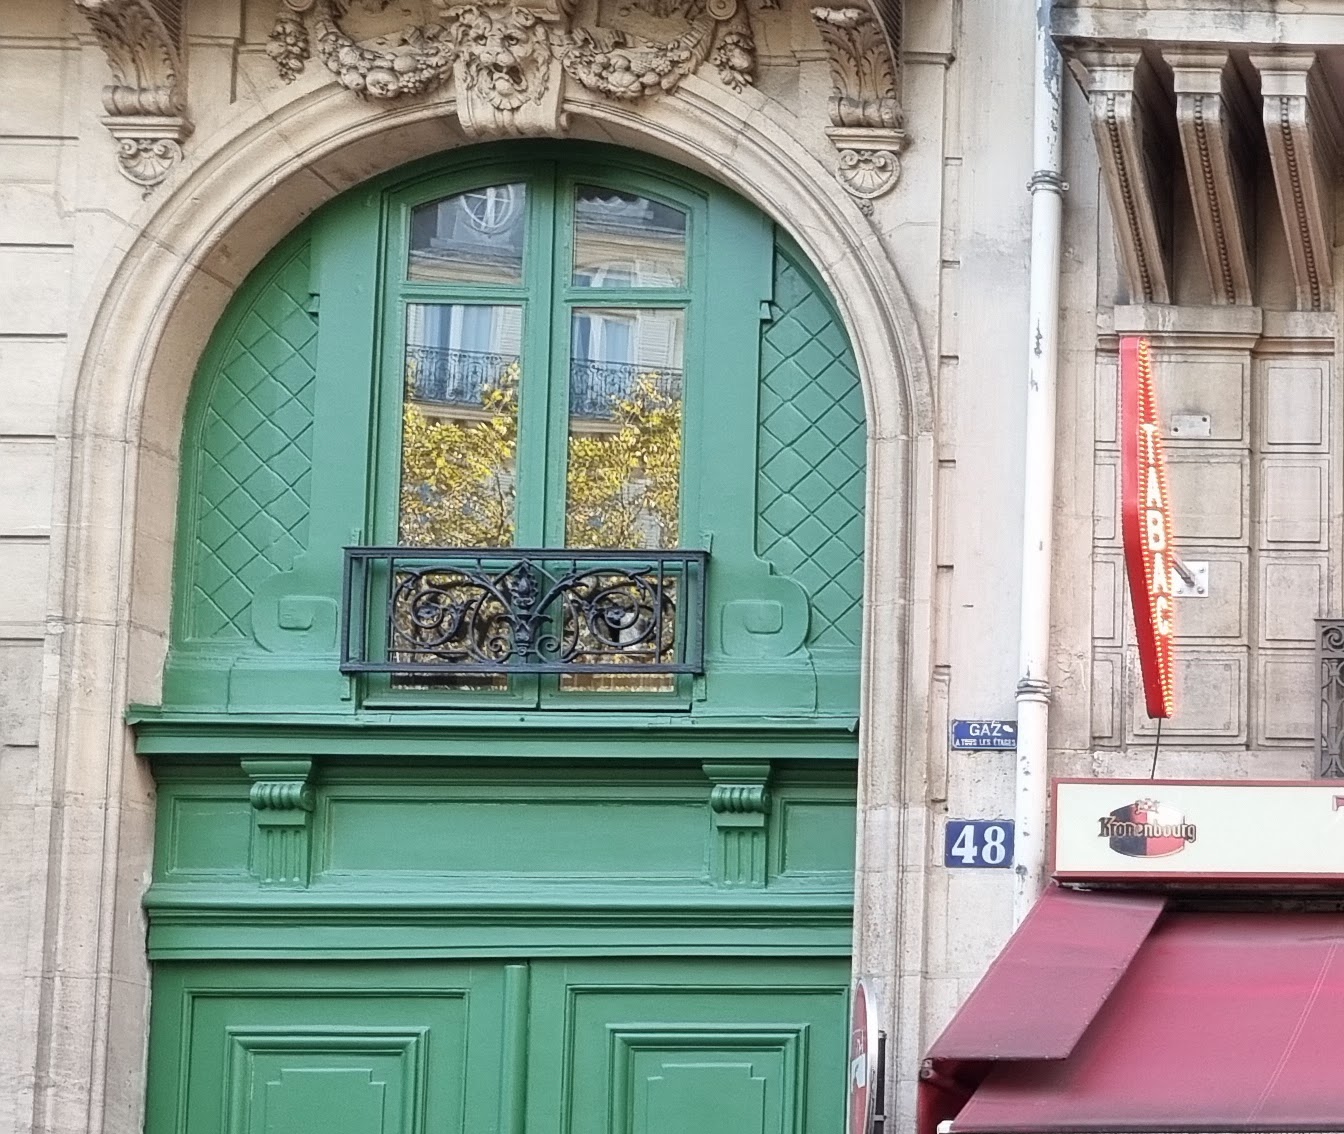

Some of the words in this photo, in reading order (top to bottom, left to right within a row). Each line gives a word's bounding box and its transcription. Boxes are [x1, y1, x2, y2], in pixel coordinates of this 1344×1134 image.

[1145, 423, 1169, 636] TABAC
[969, 723, 1002, 737] GAZ
[951, 824, 1006, 865] 48
[1098, 816, 1197, 844] Kronenbourg
